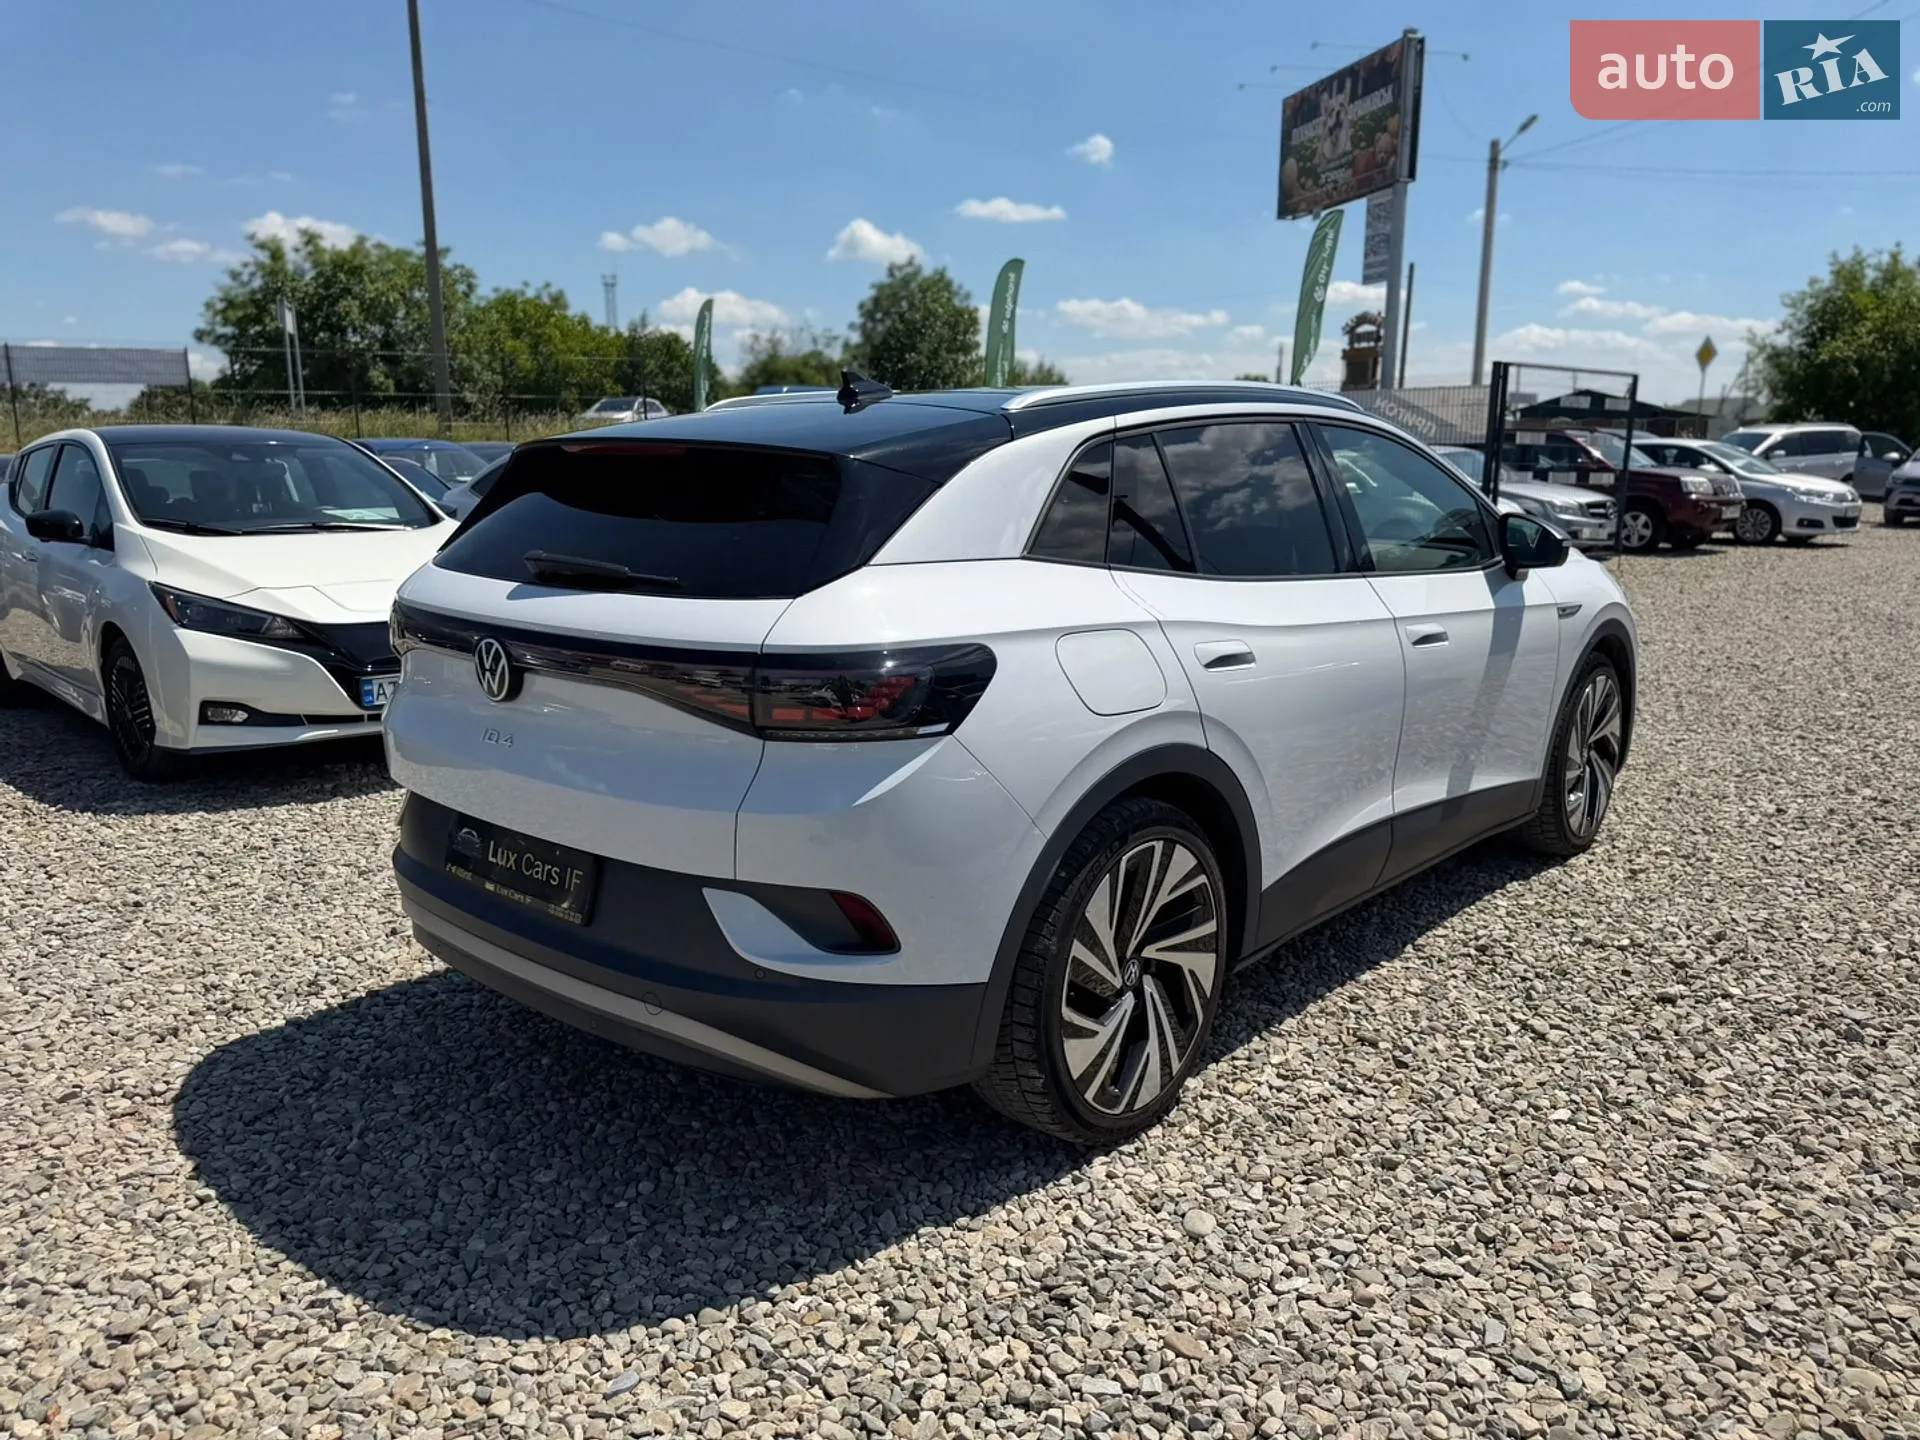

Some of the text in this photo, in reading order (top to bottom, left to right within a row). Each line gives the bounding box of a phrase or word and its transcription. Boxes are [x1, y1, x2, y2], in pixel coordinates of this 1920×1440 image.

[488, 839, 584, 892] Lux Cars IF
